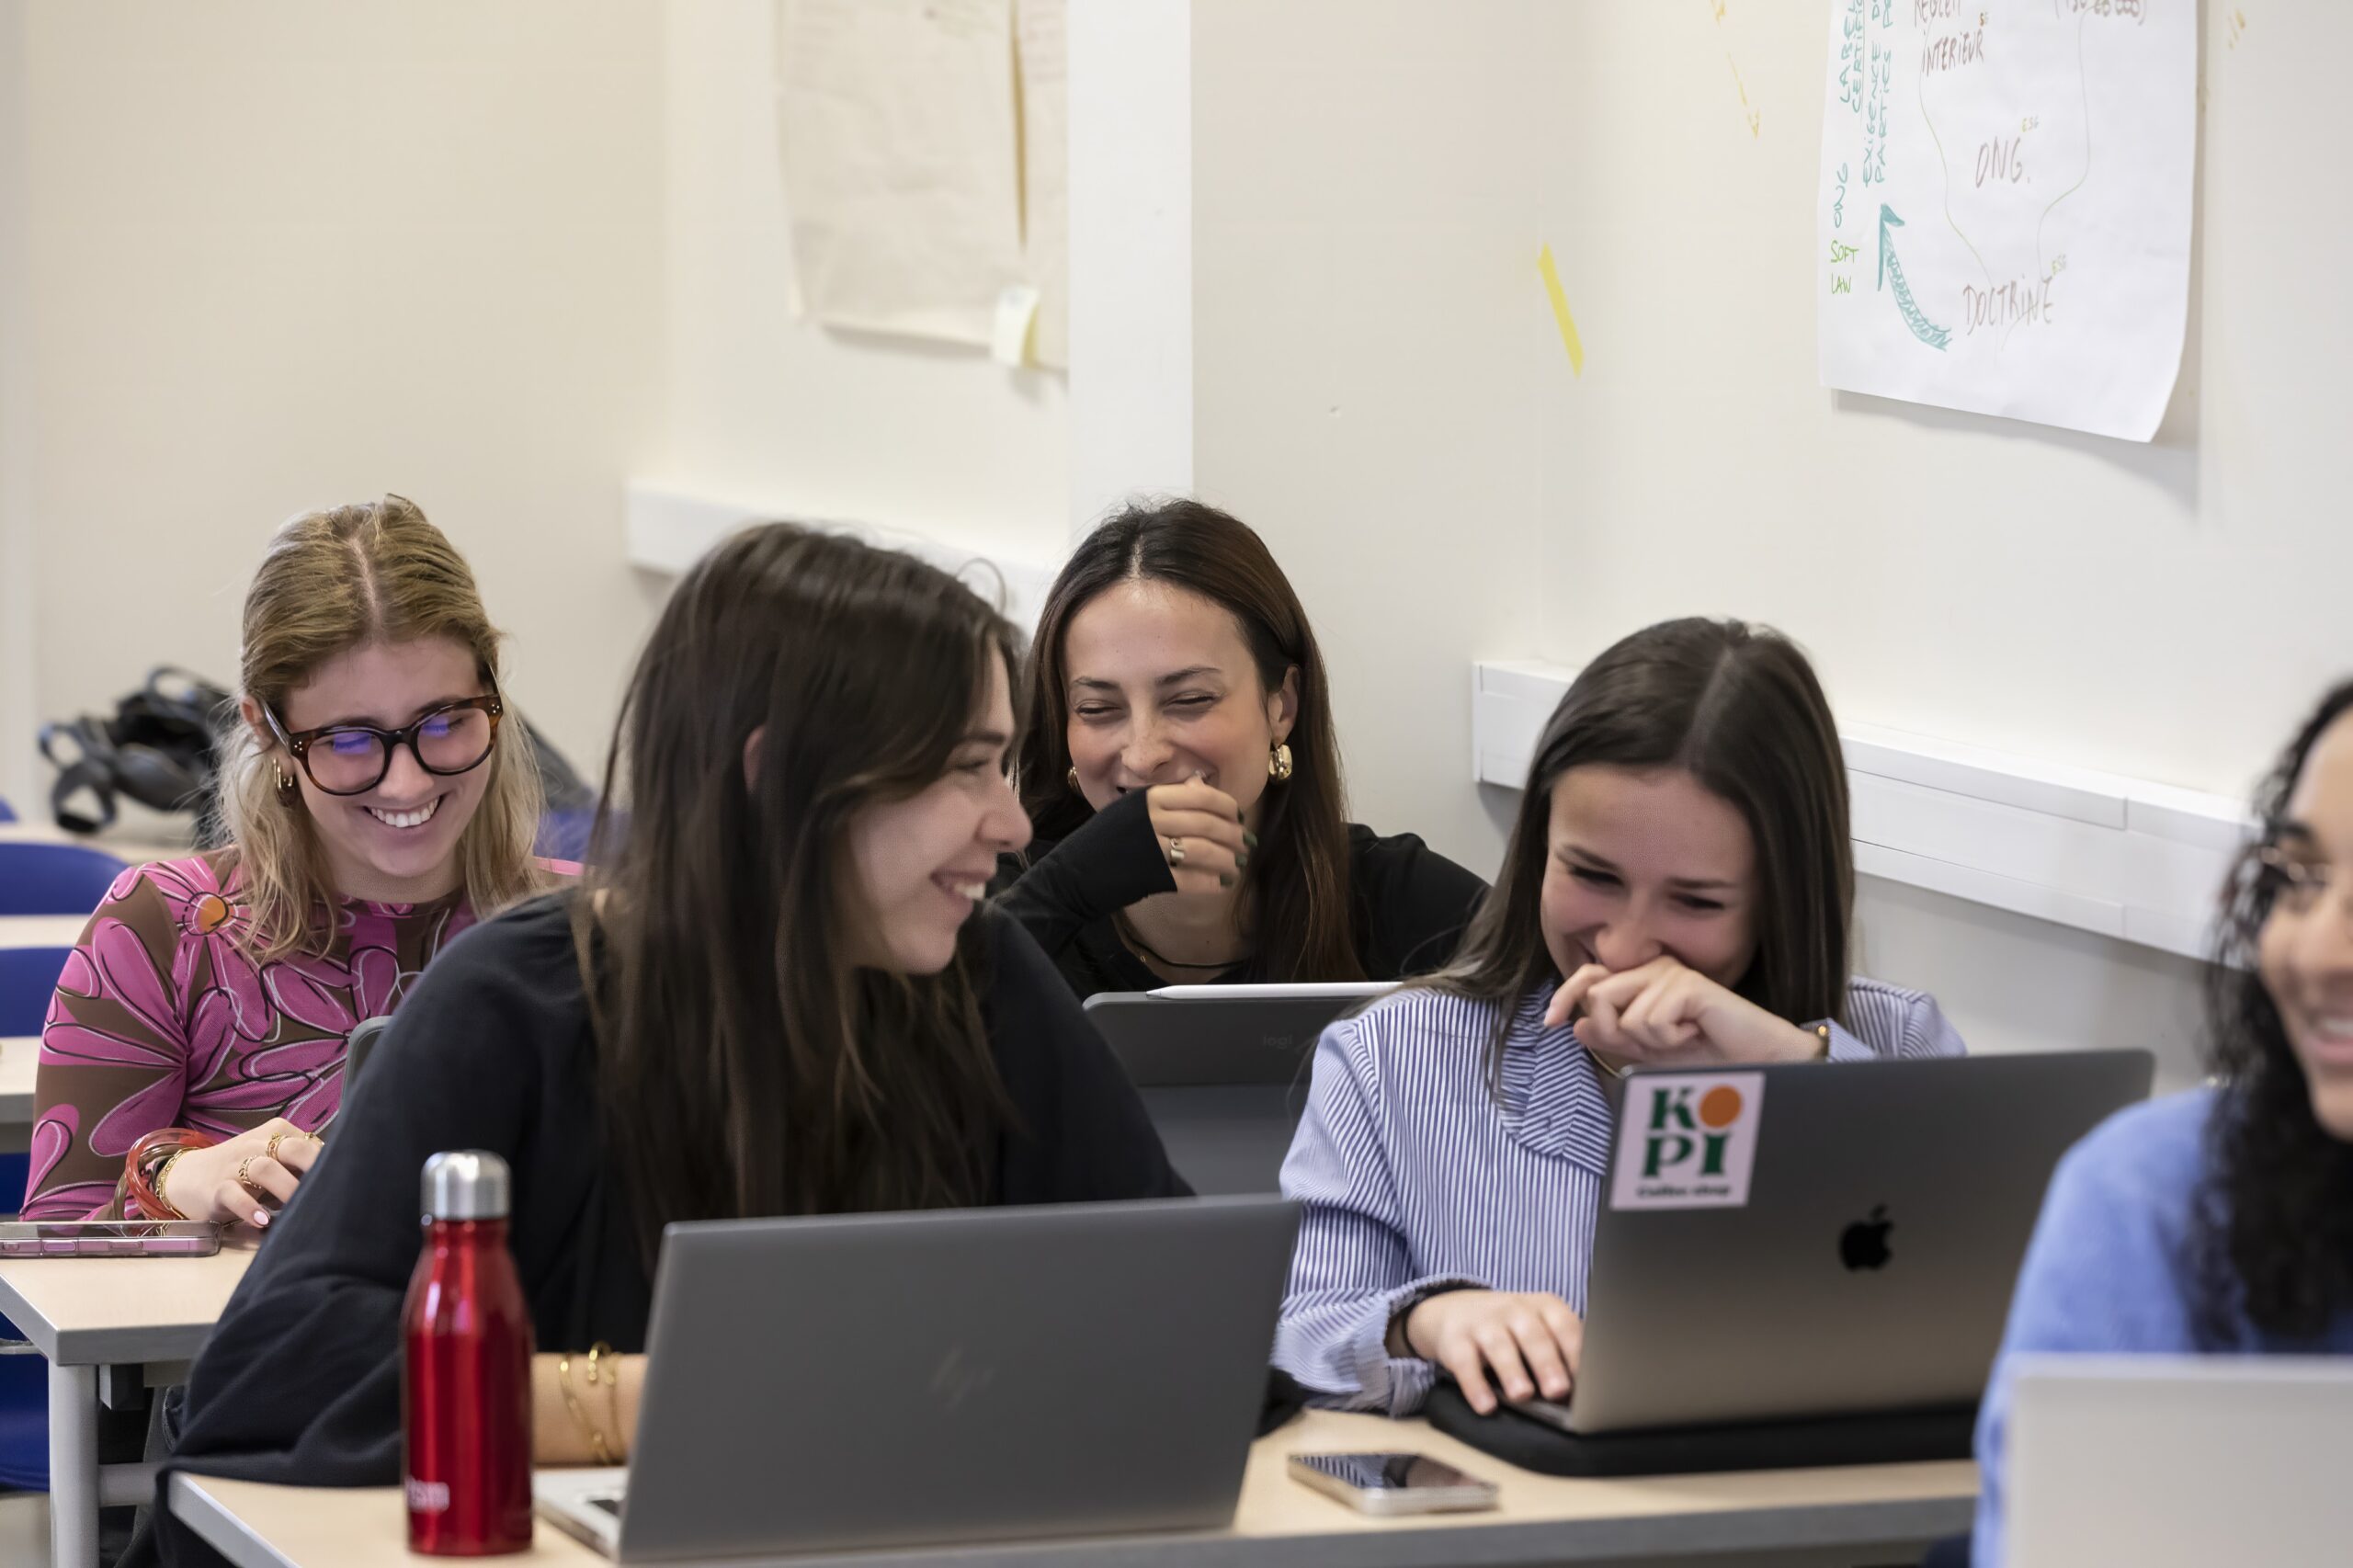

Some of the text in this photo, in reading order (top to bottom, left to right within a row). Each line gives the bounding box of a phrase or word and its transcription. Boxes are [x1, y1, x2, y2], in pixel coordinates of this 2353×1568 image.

[1830, 239, 1859, 264] SOFT
[1831, 272, 1852, 294] LAW
[1262, 1033, 1293, 1051] logi
